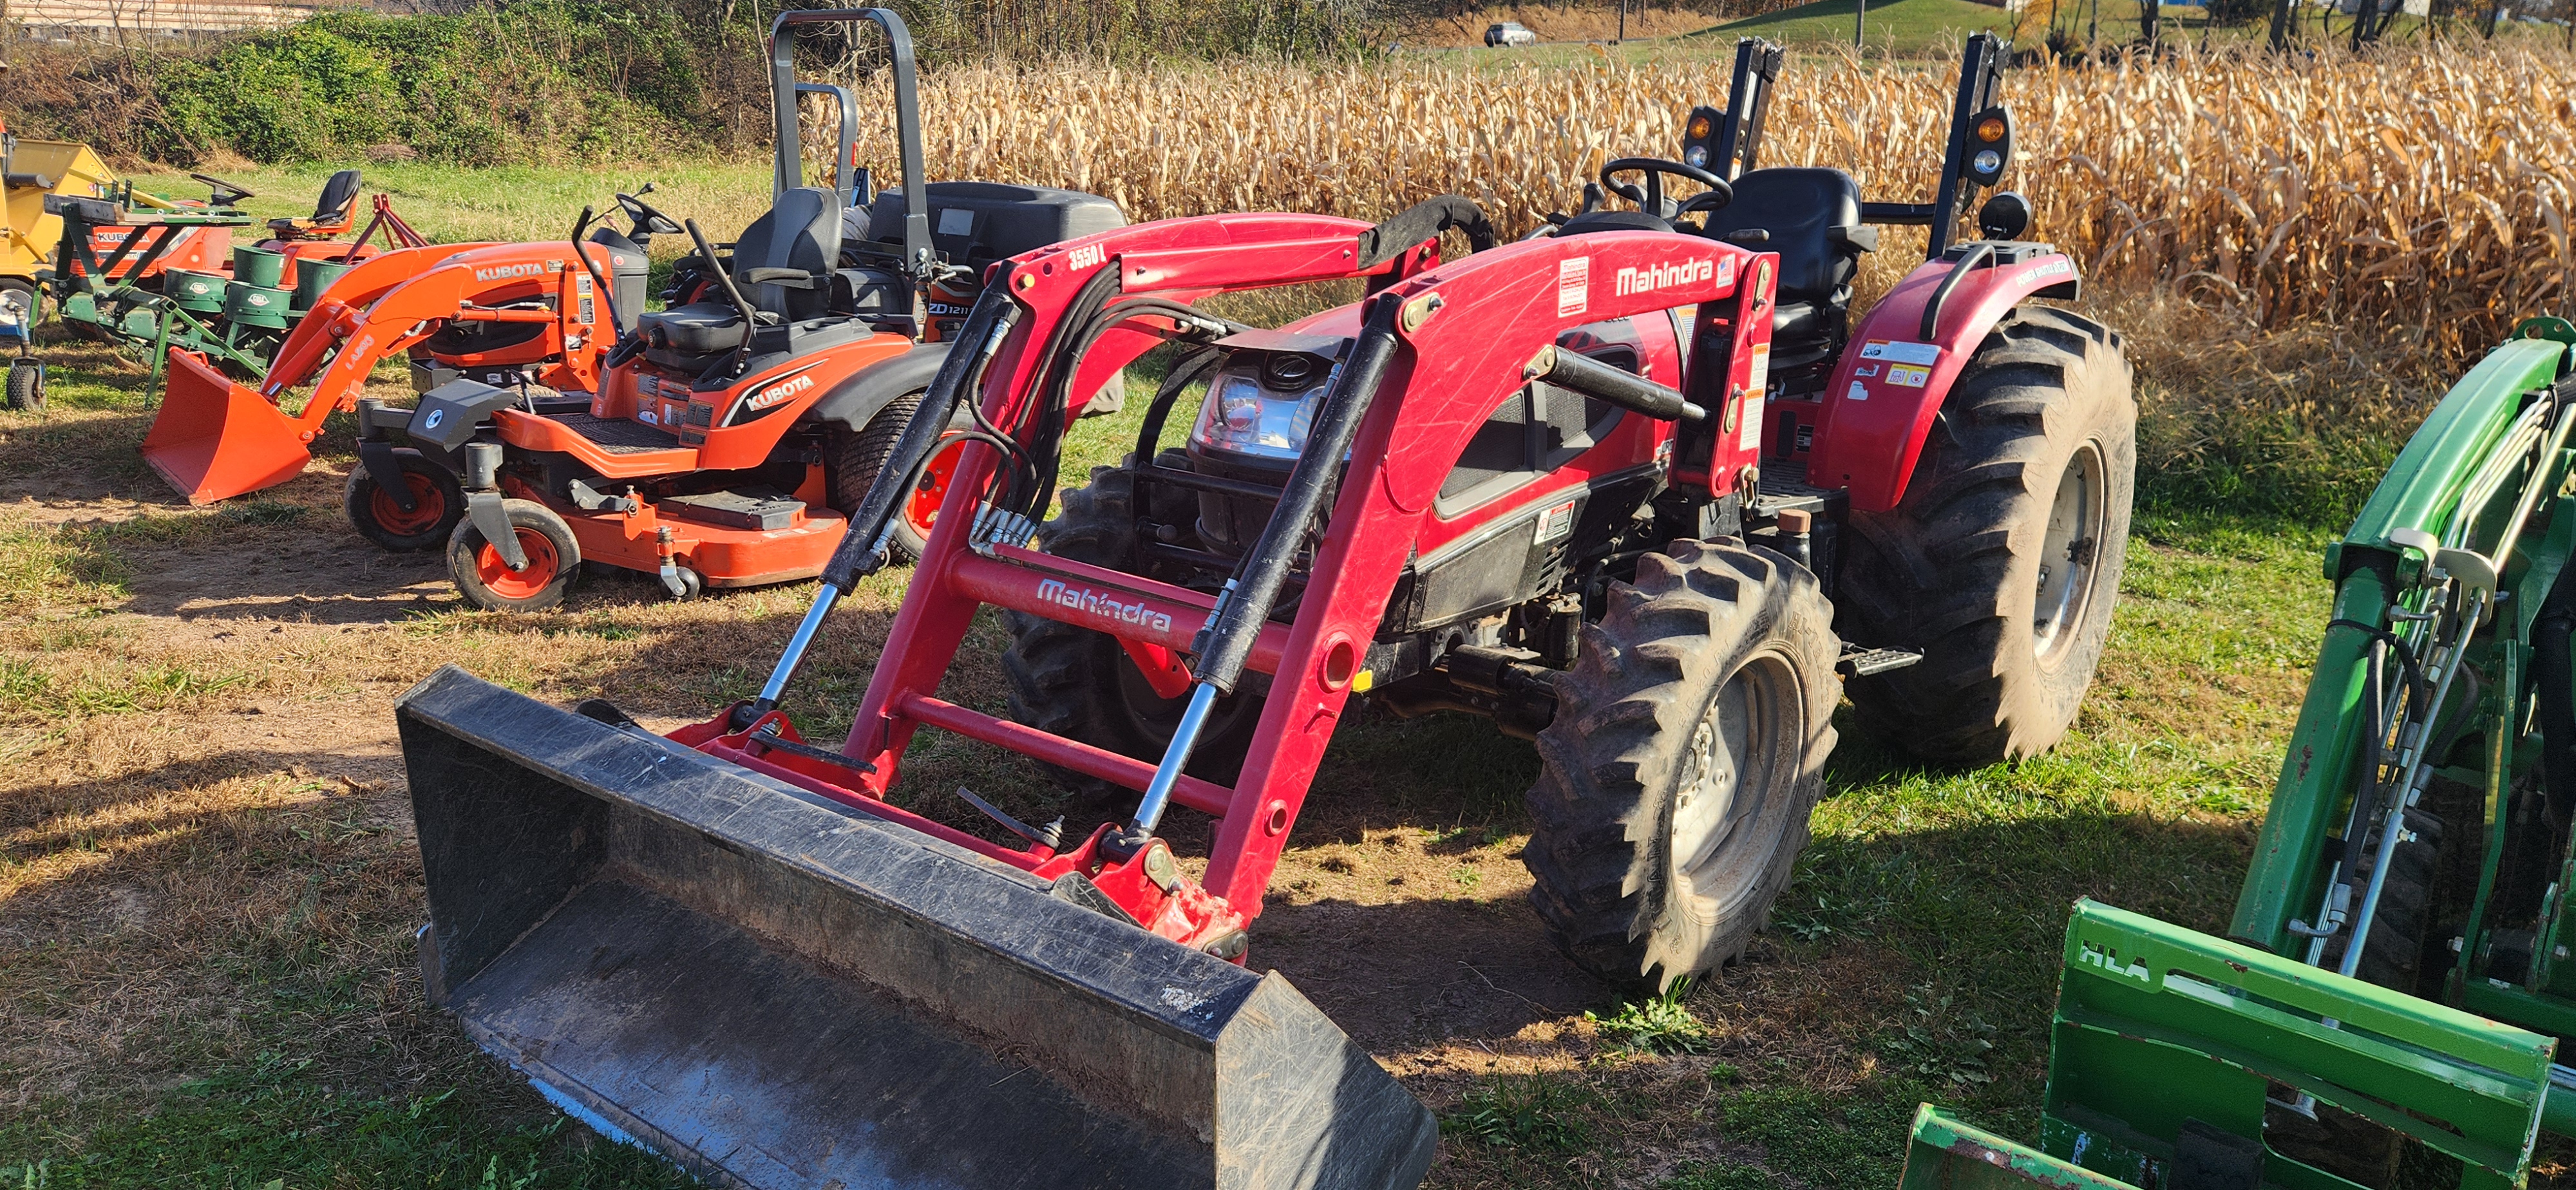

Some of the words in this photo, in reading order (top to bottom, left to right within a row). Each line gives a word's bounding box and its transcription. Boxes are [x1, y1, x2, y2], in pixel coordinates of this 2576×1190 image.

[475, 262, 544, 282] KUBOTA
[1616, 257, 1713, 297] Mahindra
[949, 306, 973, 314] 1211
[345, 334, 374, 370] LA203
[746, 375, 815, 411] KUBOTA
[1037, 578, 1172, 632] Mahindra
[2078, 939, 2150, 983] HLA
